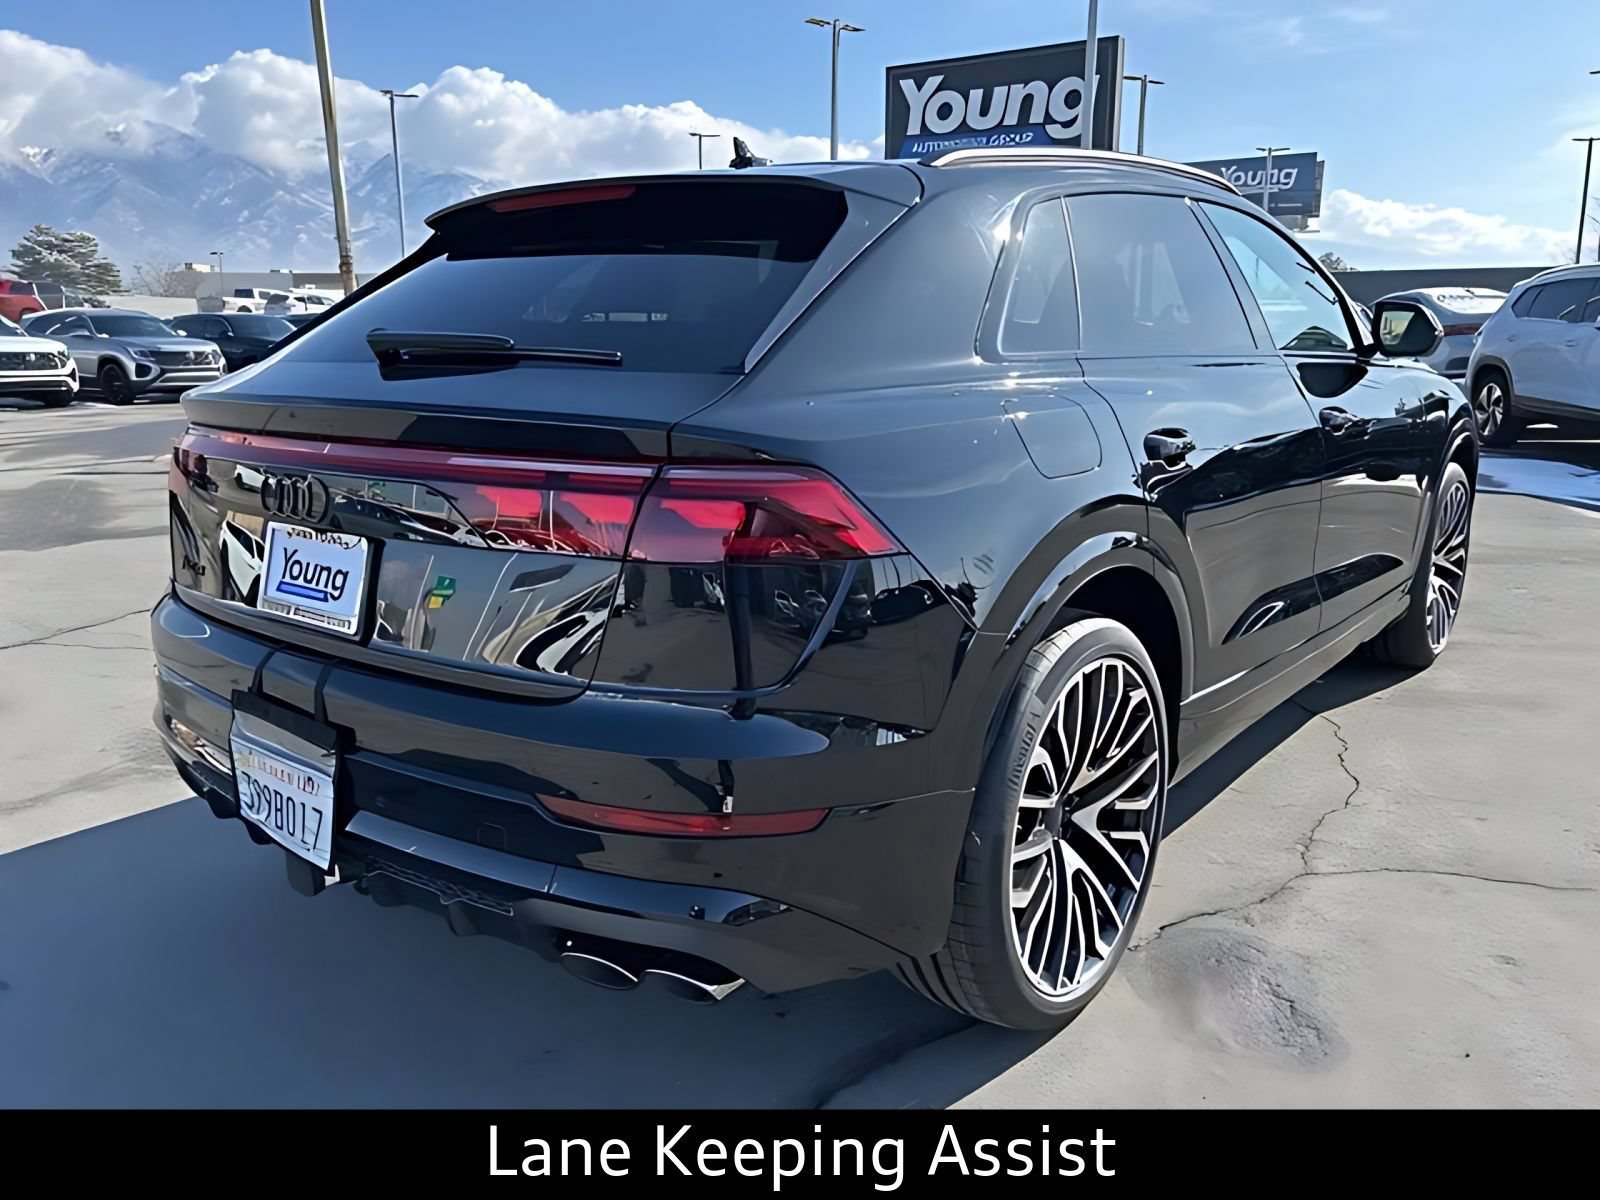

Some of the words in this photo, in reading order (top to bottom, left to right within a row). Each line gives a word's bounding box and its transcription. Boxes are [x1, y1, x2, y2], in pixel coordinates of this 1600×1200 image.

[899, 74, 1100, 139] Young
[1221, 165, 1298, 190] Young
[282, 547, 350, 601] Young
